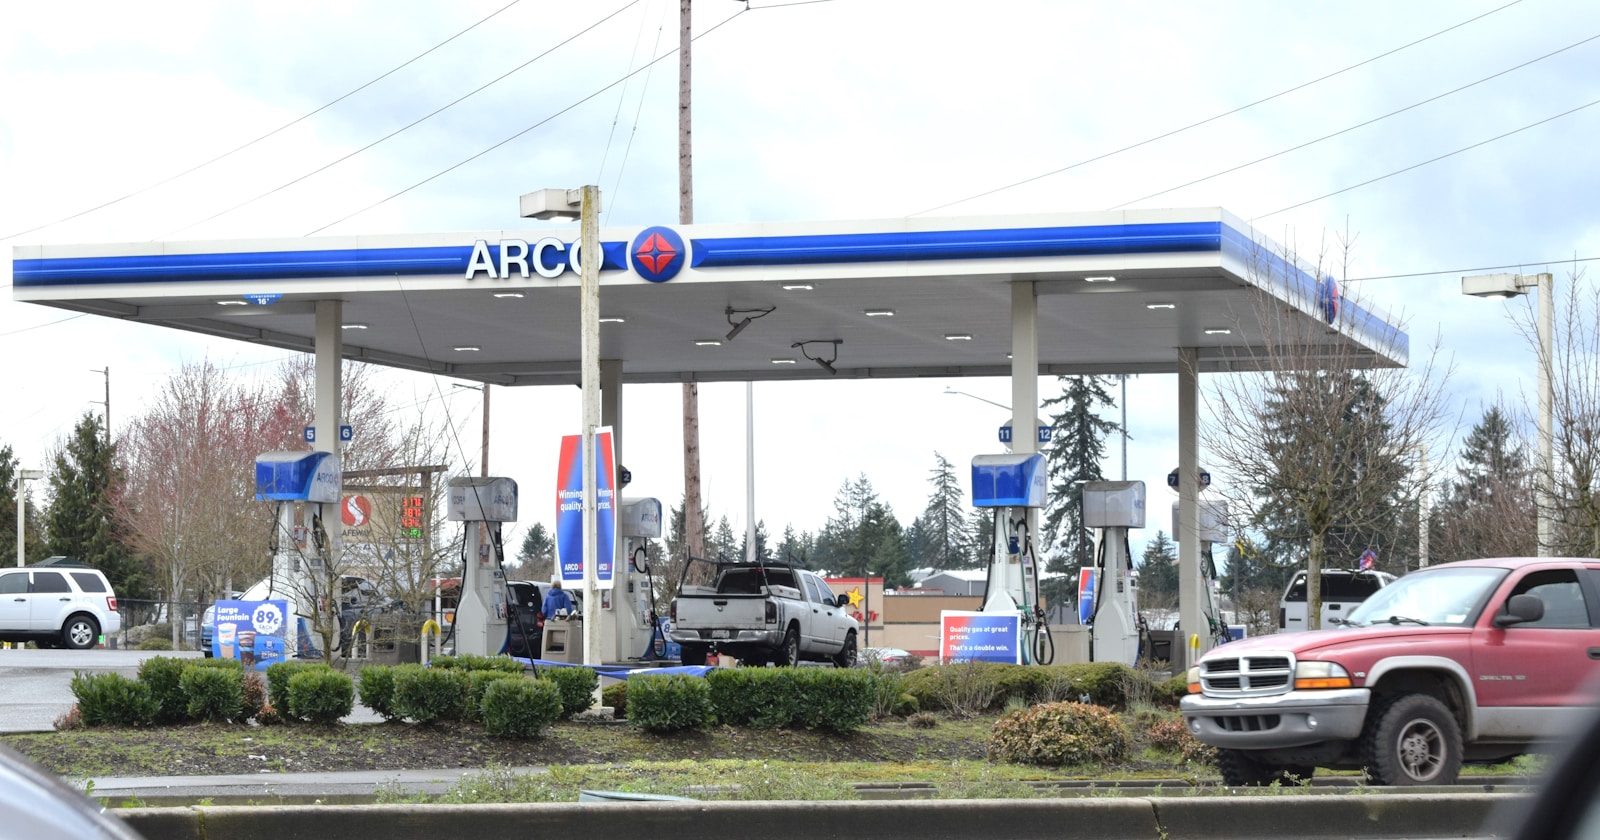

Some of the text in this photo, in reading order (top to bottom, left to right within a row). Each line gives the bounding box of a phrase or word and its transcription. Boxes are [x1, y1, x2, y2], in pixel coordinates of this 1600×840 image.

[465, 237, 604, 280] ARCO
[306, 429, 314, 440] 5
[342, 428, 350, 438] 6
[1000, 429, 1010, 440] 11
[1040, 429, 1051, 440] 12
[623, 473, 630, 481] 2
[1169, 476, 1176, 485] 7
[558, 489, 583, 500] Winning
[560, 501, 584, 512] quality.
[564, 563, 579, 571] ARCO
[217, 613, 250, 621] Fountain
[949, 626, 970, 634] Quality
